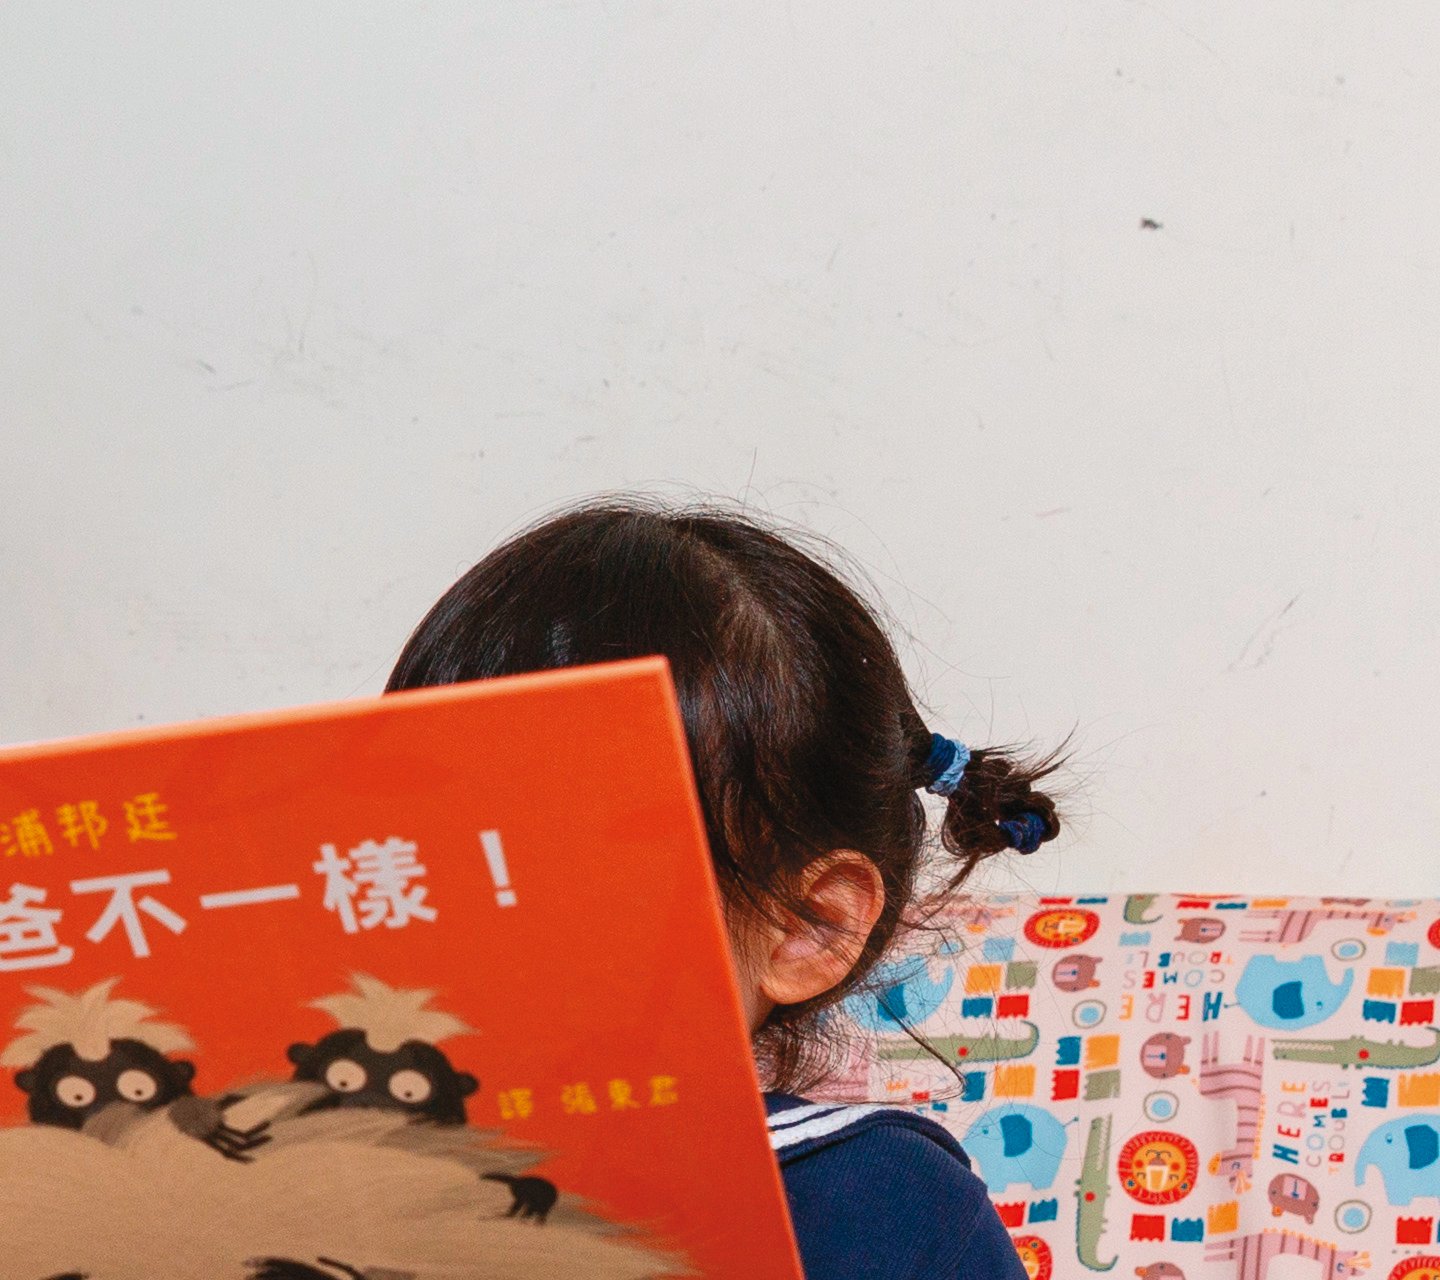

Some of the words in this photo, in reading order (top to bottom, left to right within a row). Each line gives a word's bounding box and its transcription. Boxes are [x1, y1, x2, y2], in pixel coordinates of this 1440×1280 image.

[1118, 991, 1224, 1023] HERE
[1122, 969, 1225, 989] COMES
[1272, 1081, 1307, 1165] HERE
[1305, 1081, 1330, 1167] COMES
